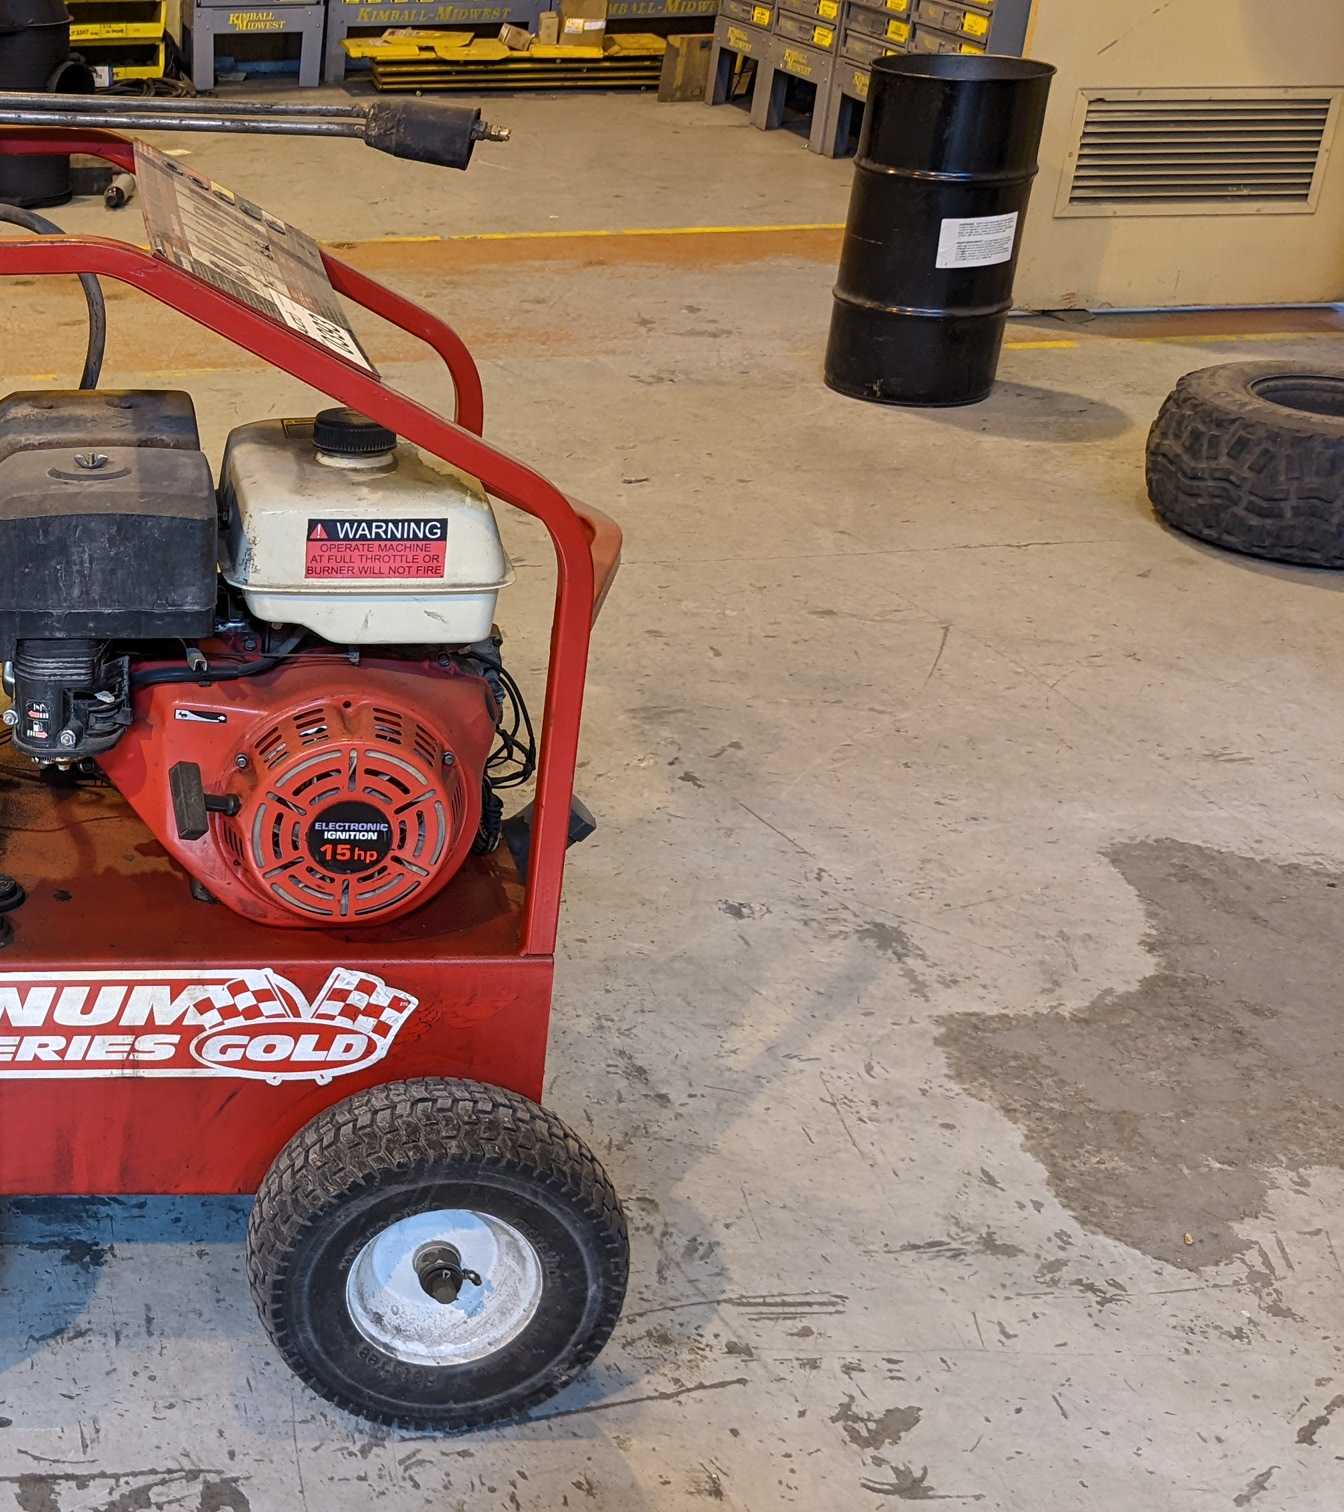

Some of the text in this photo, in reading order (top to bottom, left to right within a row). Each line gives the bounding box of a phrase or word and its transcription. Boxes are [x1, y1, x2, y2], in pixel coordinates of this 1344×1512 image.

[229, 11, 274, 25] KIMBALL
[236, 19, 286, 31] MIDWEST
[336, 521, 442, 539] WARNING
[320, 543, 432, 553] OPERATE MACHINE
[309, 554, 440, 564] AT FULL THROTTLE OR
[307, 565, 442, 575] BURNER WILL NOT FIRE
[314, 822, 389, 831] ELECTRONIC
[323, 831, 378, 840] IGNITION
[320, 844, 378, 864] 15 hp
[202, 1034, 369, 1062] GOLD
